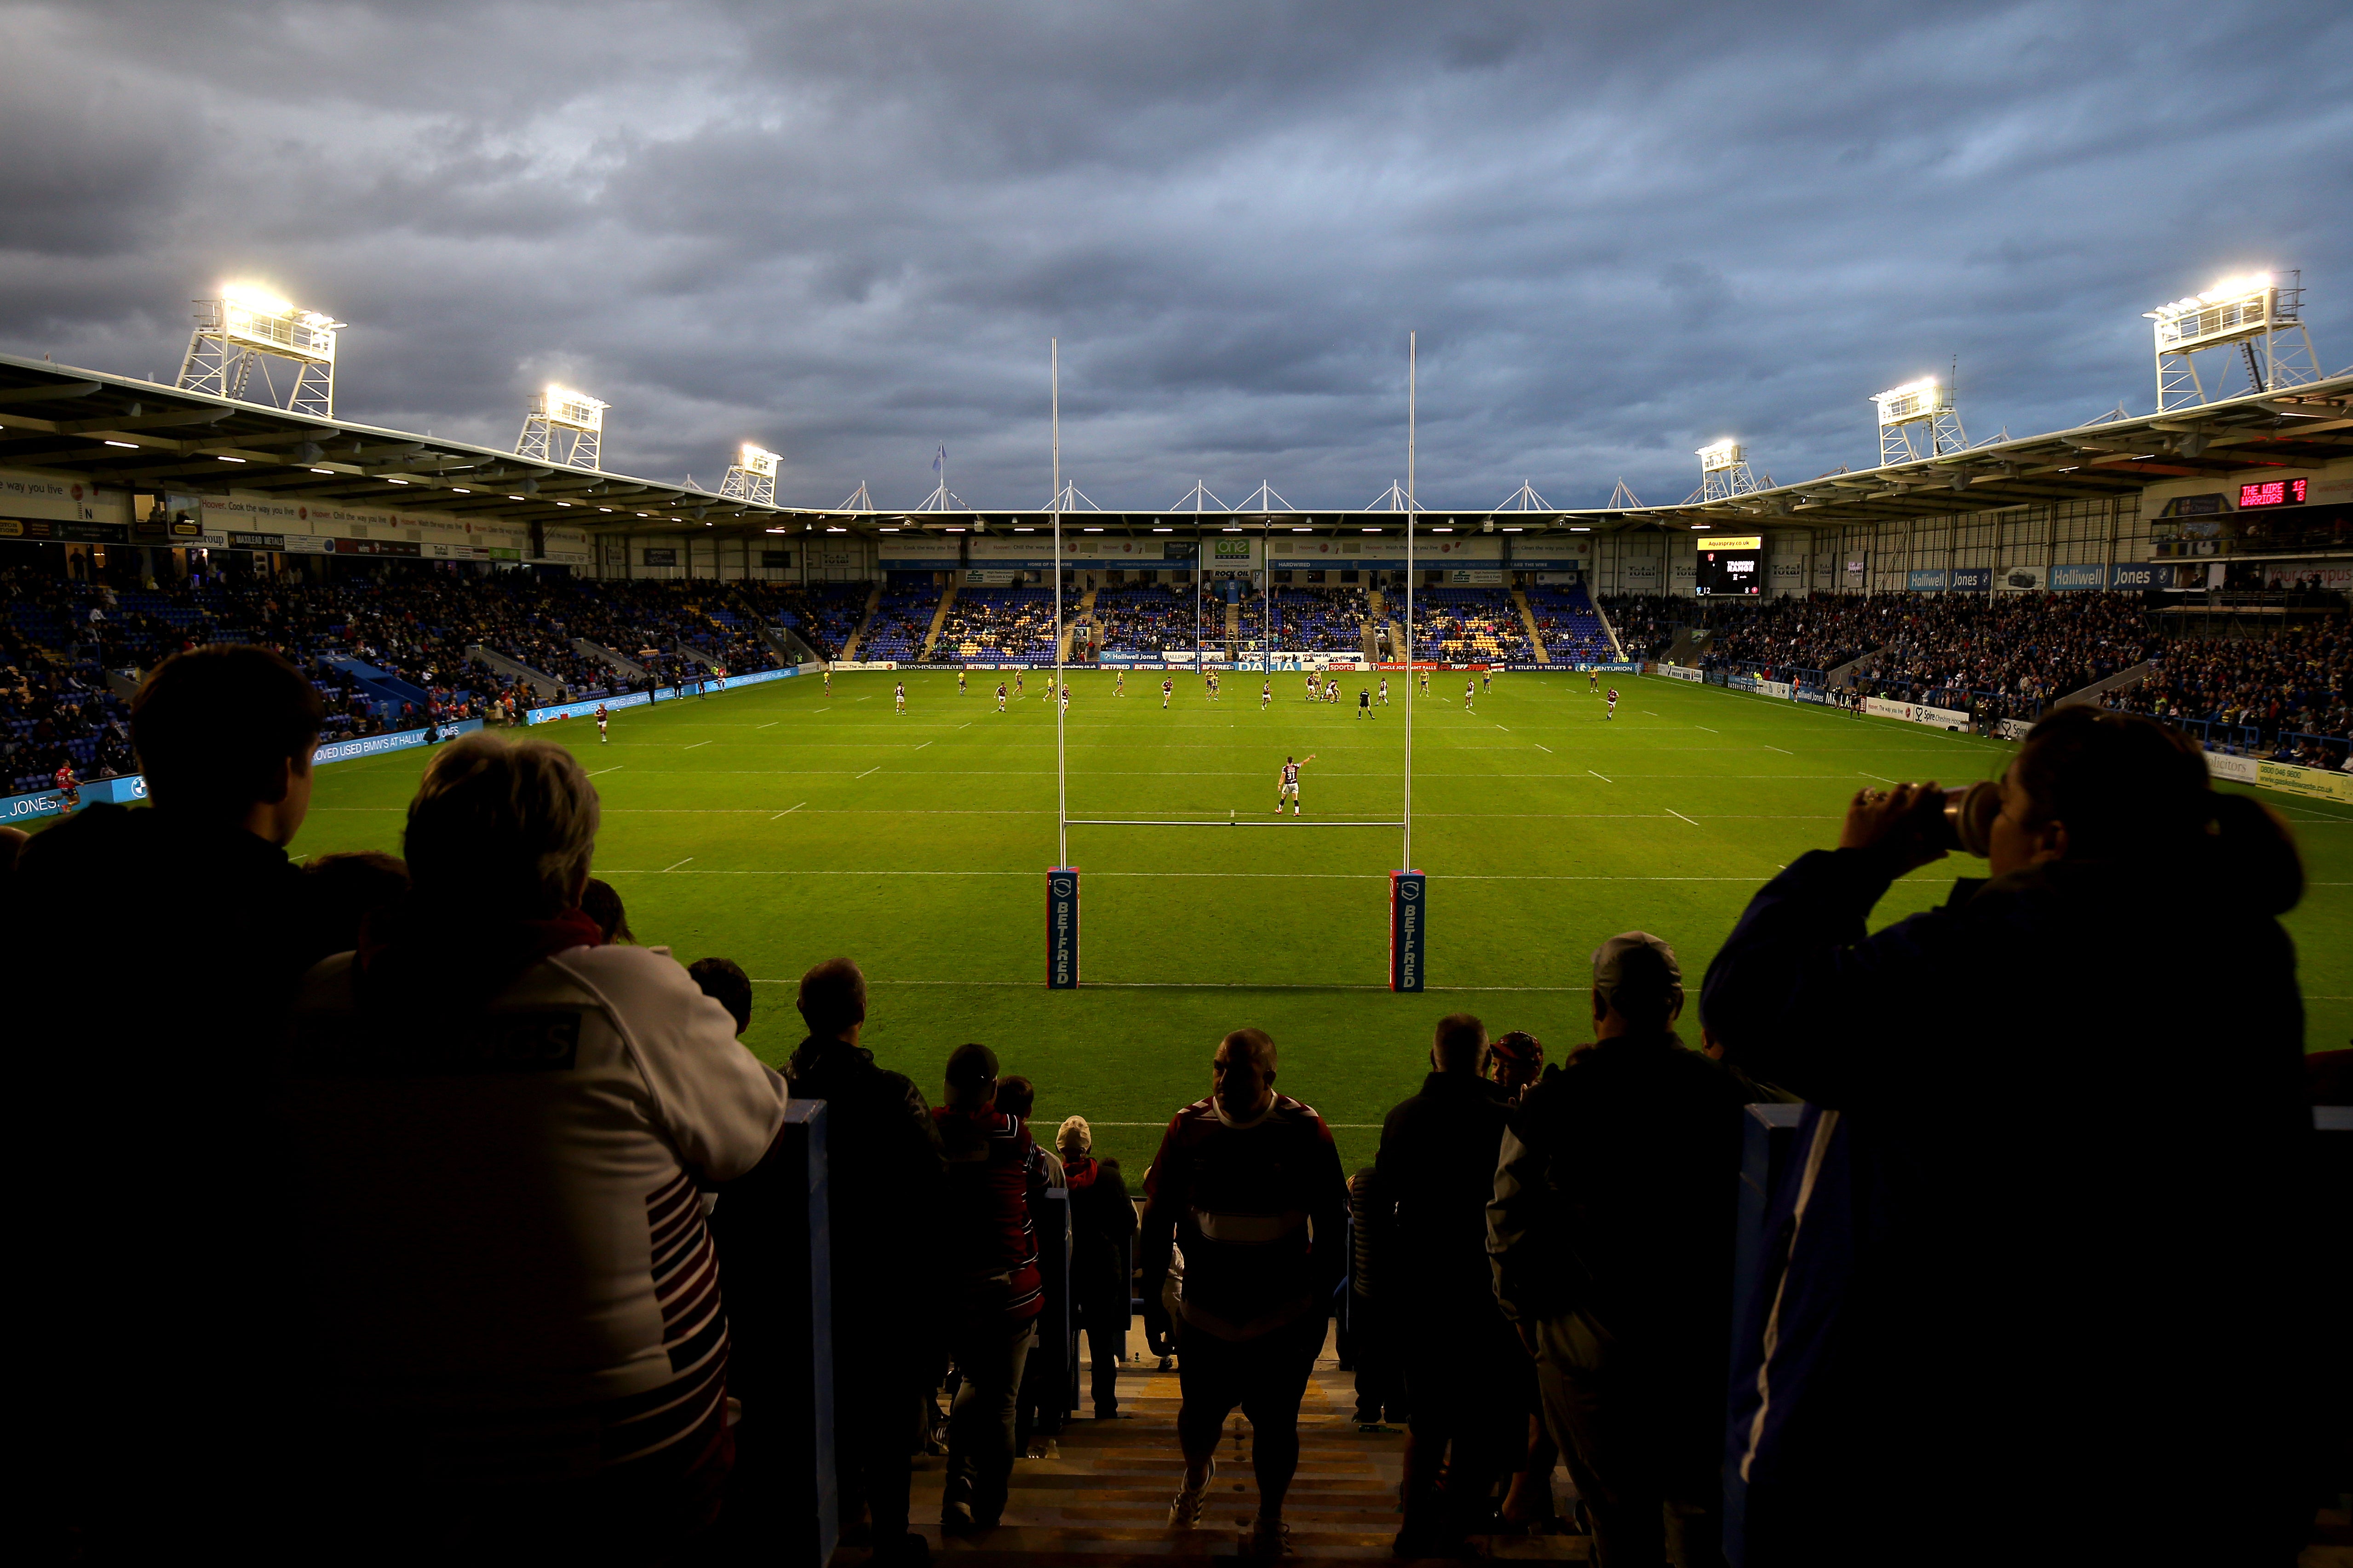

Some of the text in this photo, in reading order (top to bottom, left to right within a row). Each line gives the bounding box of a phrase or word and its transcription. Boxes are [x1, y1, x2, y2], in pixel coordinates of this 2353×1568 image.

[6, 482, 24, 493] way
[28, 484, 45, 494] you
[48, 484, 63, 495] live
[2243, 480, 2305, 496] THE WIRE 12
[2241, 491, 2304, 506] WARRIORS 8
[202, 499, 226, 510] Hoover.
[229, 502, 244, 511] Cook
[258, 506, 270, 515] way
[272, 507, 283, 515] you
[284, 507, 294, 515] live
[85, 509, 92, 519] N
[236, 534, 263, 544] MAXILEAD
[264, 536, 283, 546] METALS
[1218, 541, 1246, 552] one
[823, 554, 849, 564] Total
[1628, 566, 1655, 576] Total
[1676, 566, 1697, 576] Tota
[1772, 563, 1800, 575] Total
[2270, 567, 2296, 582] Your
[1911, 572, 1977, 587] Halliwell Jones
[2054, 567, 2150, 586] Halliwell Jones
[1812, 692, 1824, 703] Jones
[551, 707, 571, 716] CHOOSE
[585, 704, 596, 712] OVER
[626, 696, 636, 705] USED
[1924, 710, 1951, 723] Spire Cheshire
[2013, 724, 2027, 737] Spire
[340, 744, 362, 756] USED
[364, 738, 389, 752] BMW'S
[390, 737, 398, 747] AT
[2261, 765, 2274, 774] 0800
[2260, 775, 2334, 793] www.gaskellswaste.co.uk
[1057, 902, 1069, 984] BETFRED
[1403, 904, 1416, 988] BETFRED
